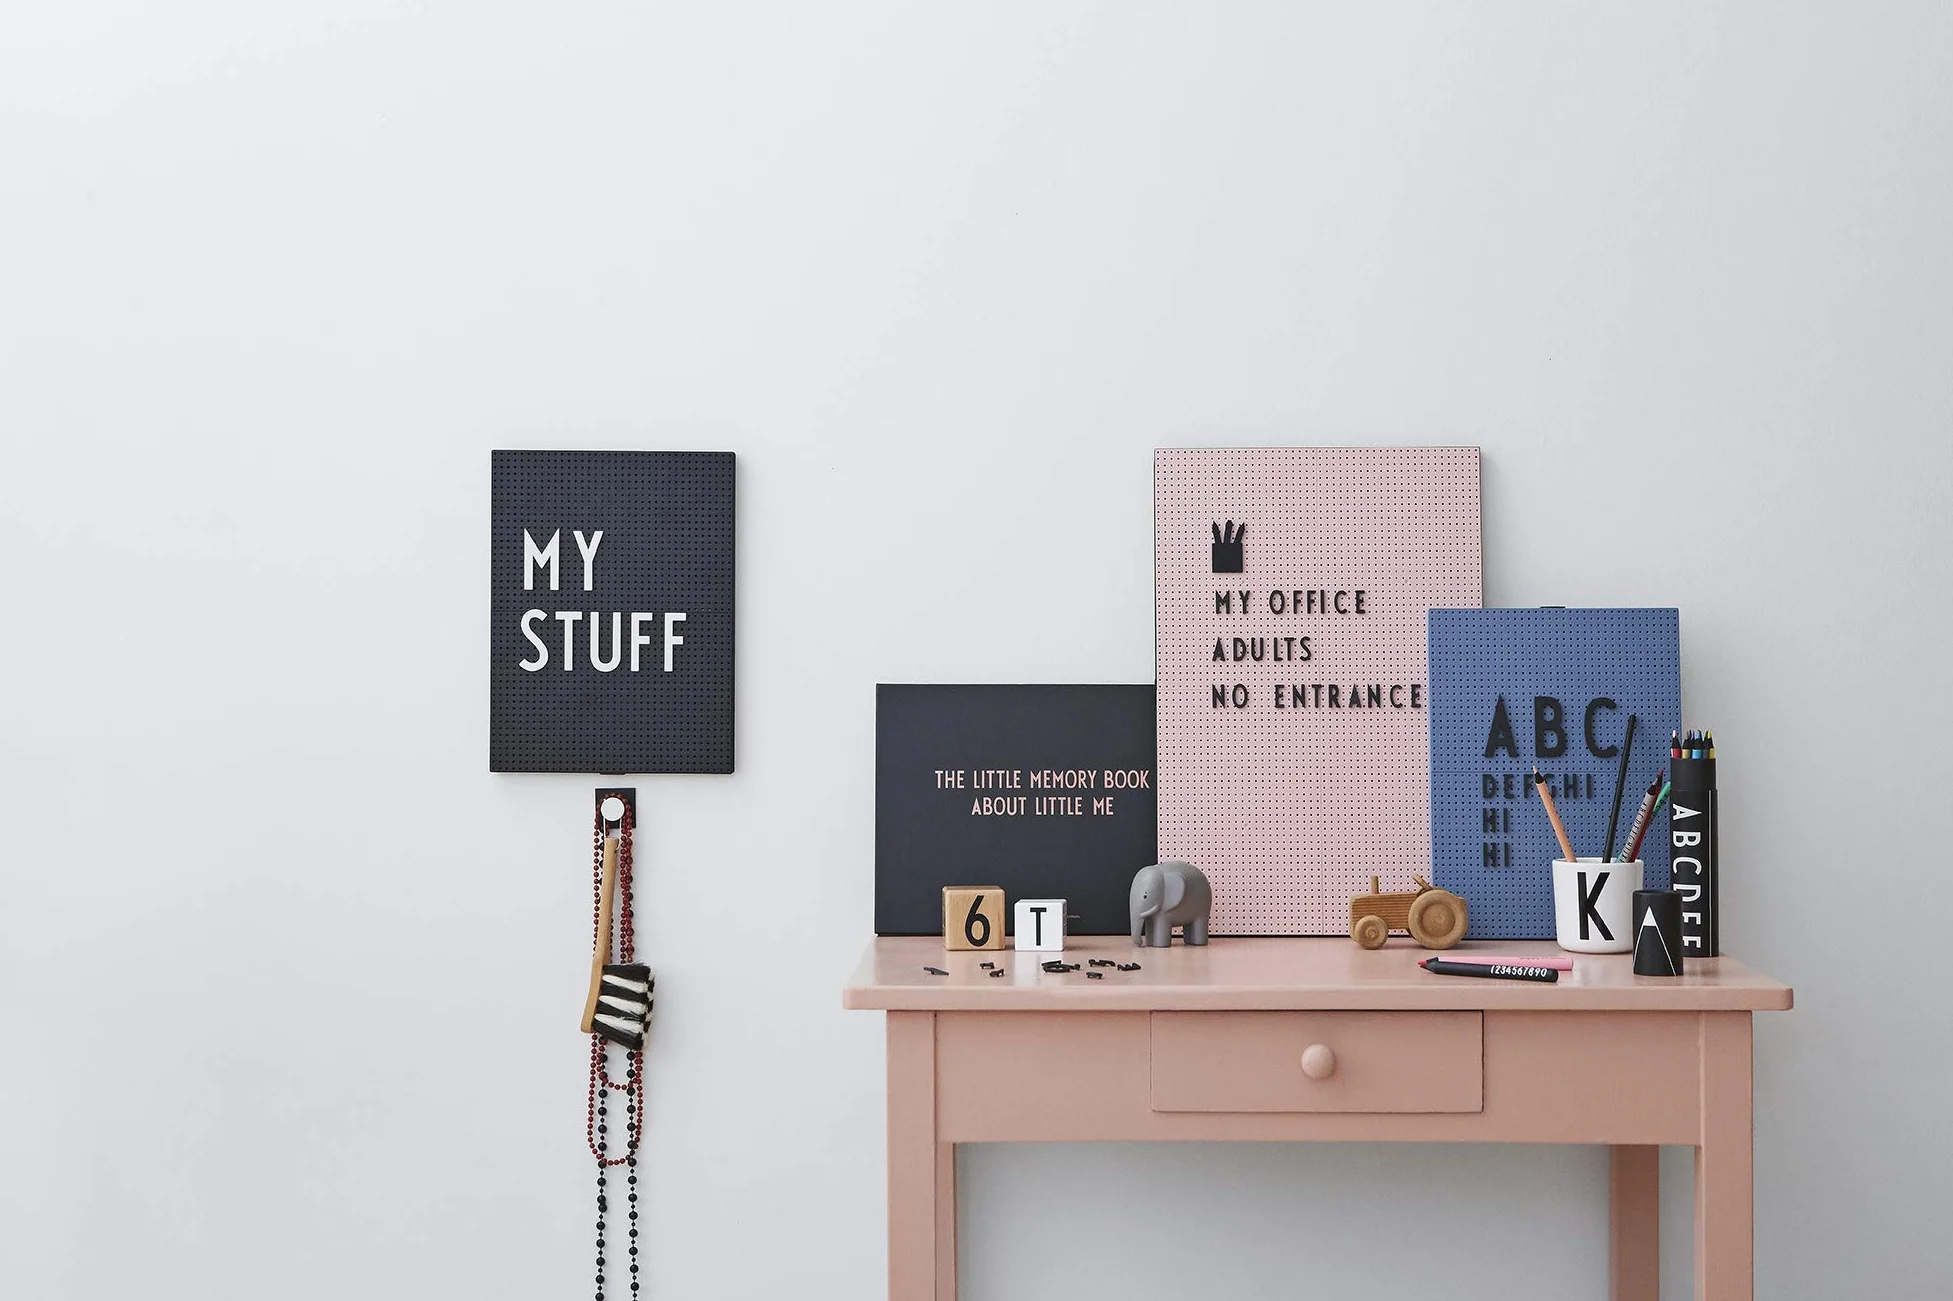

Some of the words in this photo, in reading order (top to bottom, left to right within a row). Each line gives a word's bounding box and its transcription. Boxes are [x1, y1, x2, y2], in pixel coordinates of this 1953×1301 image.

[524, 528, 603, 591] MY
[1215, 590, 1250, 615] MY
[1269, 590, 1366, 615] OFFICE
[518, 608, 687, 673] STUFF
[1212, 636, 1312, 662] ADULTS
[1212, 684, 1249, 709] NO
[1274, 684, 1422, 709] ENTRANCE
[1483, 694, 1620, 759] ABC
[934, 770, 965, 789] THE
[973, 770, 1021, 789] LITTLE
[1030, 770, 1097, 789] MEMORY
[1104, 770, 1150, 789] BOOK
[971, 797, 1026, 816] ABOUT
[1035, 797, 1083, 816] LITTLE
[1093, 797, 1114, 816] ME
[1482, 807, 1510, 834] HI
[1482, 841, 1510, 869] HI
[1577, 872, 1616, 941] K
[965, 895, 991, 947] 6
[1029, 907, 1047, 946] T
[1490, 964, 1548, 978] 1234567890
